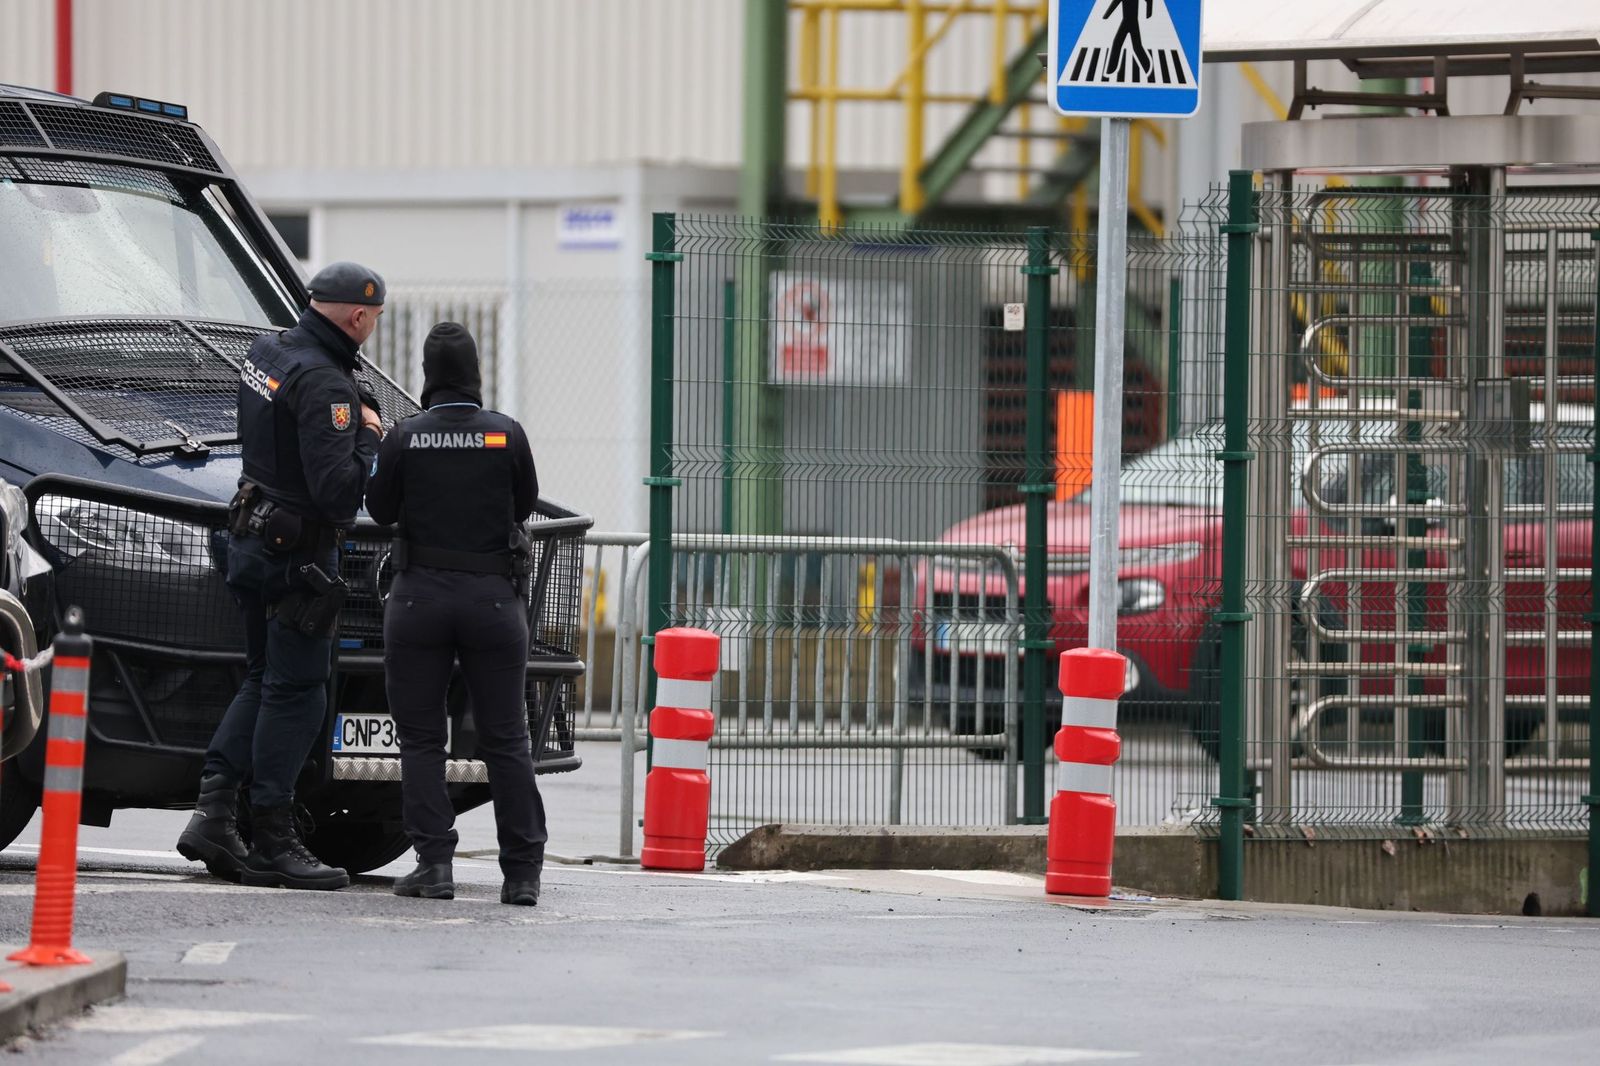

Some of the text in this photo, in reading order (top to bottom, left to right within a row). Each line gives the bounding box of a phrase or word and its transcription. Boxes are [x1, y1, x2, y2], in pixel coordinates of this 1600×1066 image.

[241, 370, 272, 401] NACIONAL
[243, 359, 270, 387] POLICIA
[409, 432, 484, 448] ADUANAS
